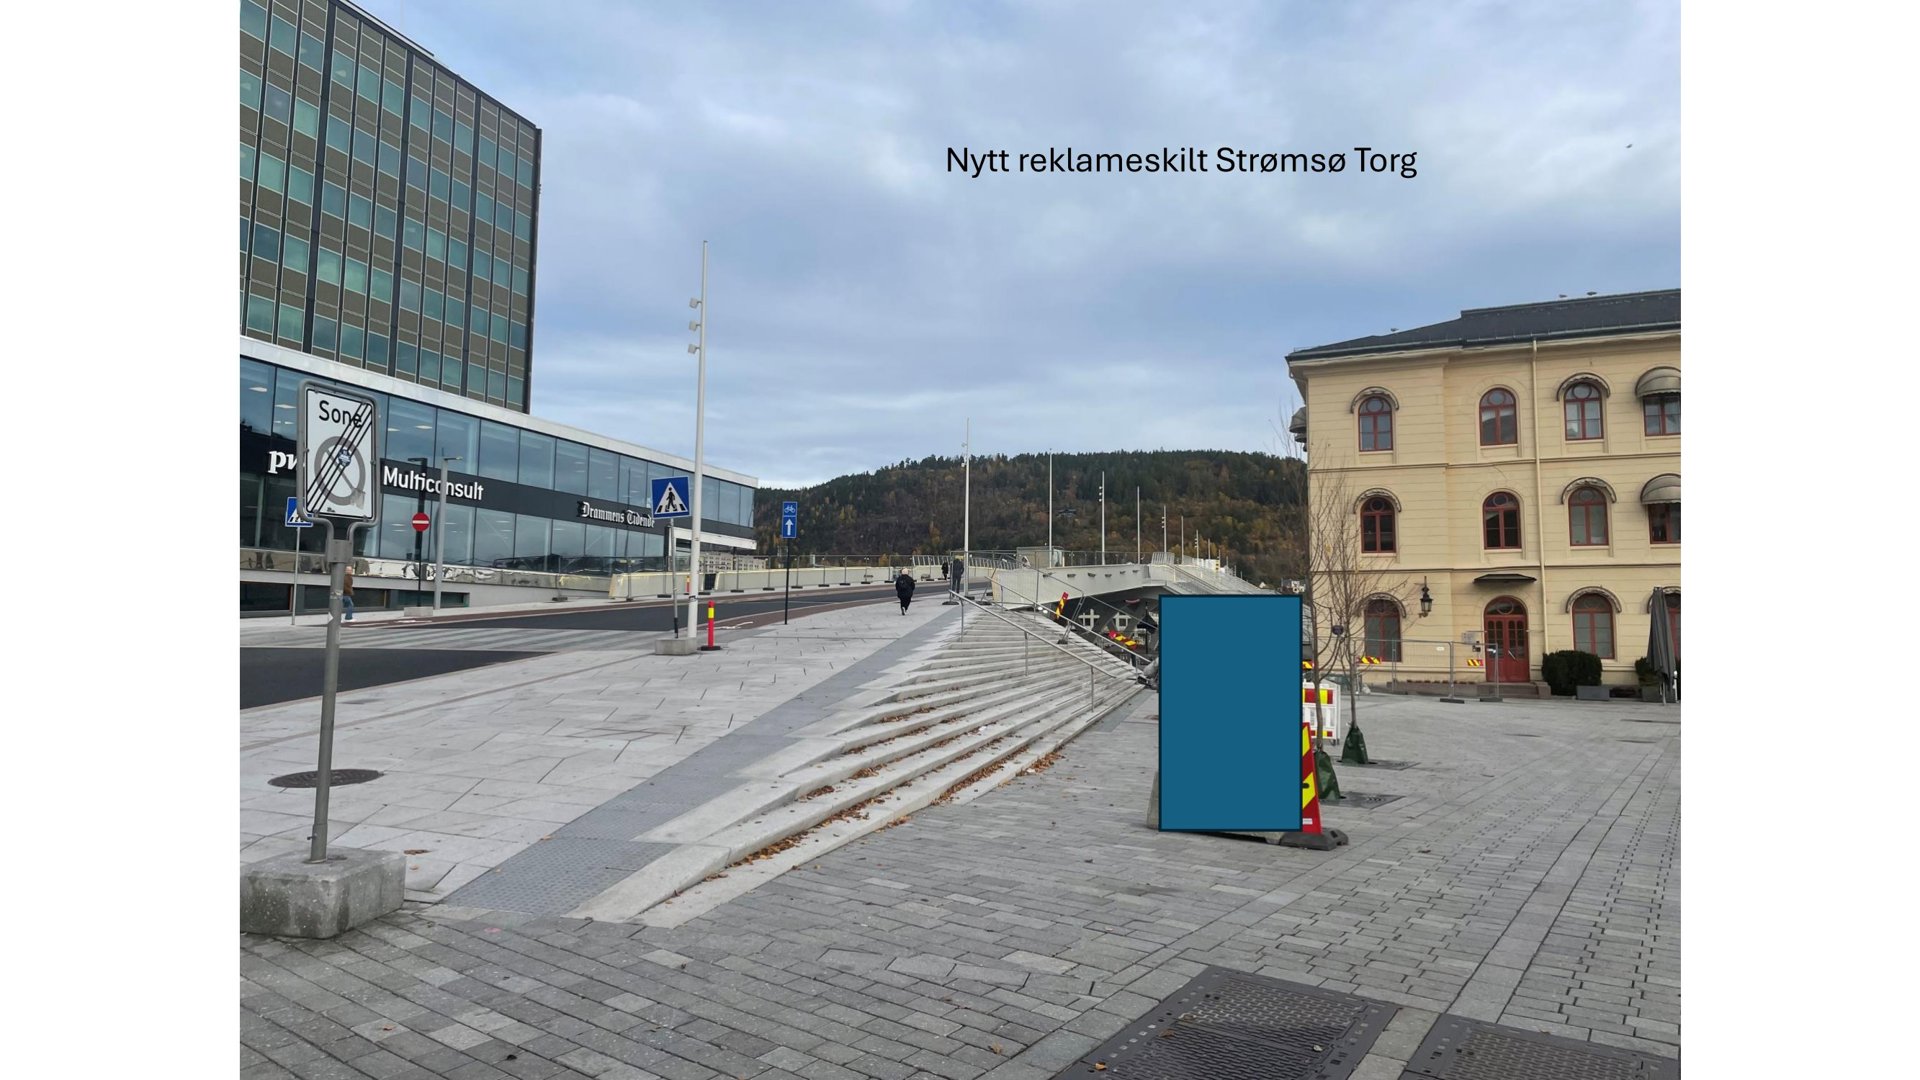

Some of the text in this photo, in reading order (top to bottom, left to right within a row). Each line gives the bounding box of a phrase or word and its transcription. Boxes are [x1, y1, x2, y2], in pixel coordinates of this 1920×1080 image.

[319, 400, 362, 428] Sone
[383, 465, 485, 501] Multiconsult
[581, 501, 655, 528] Drammens Tidende
